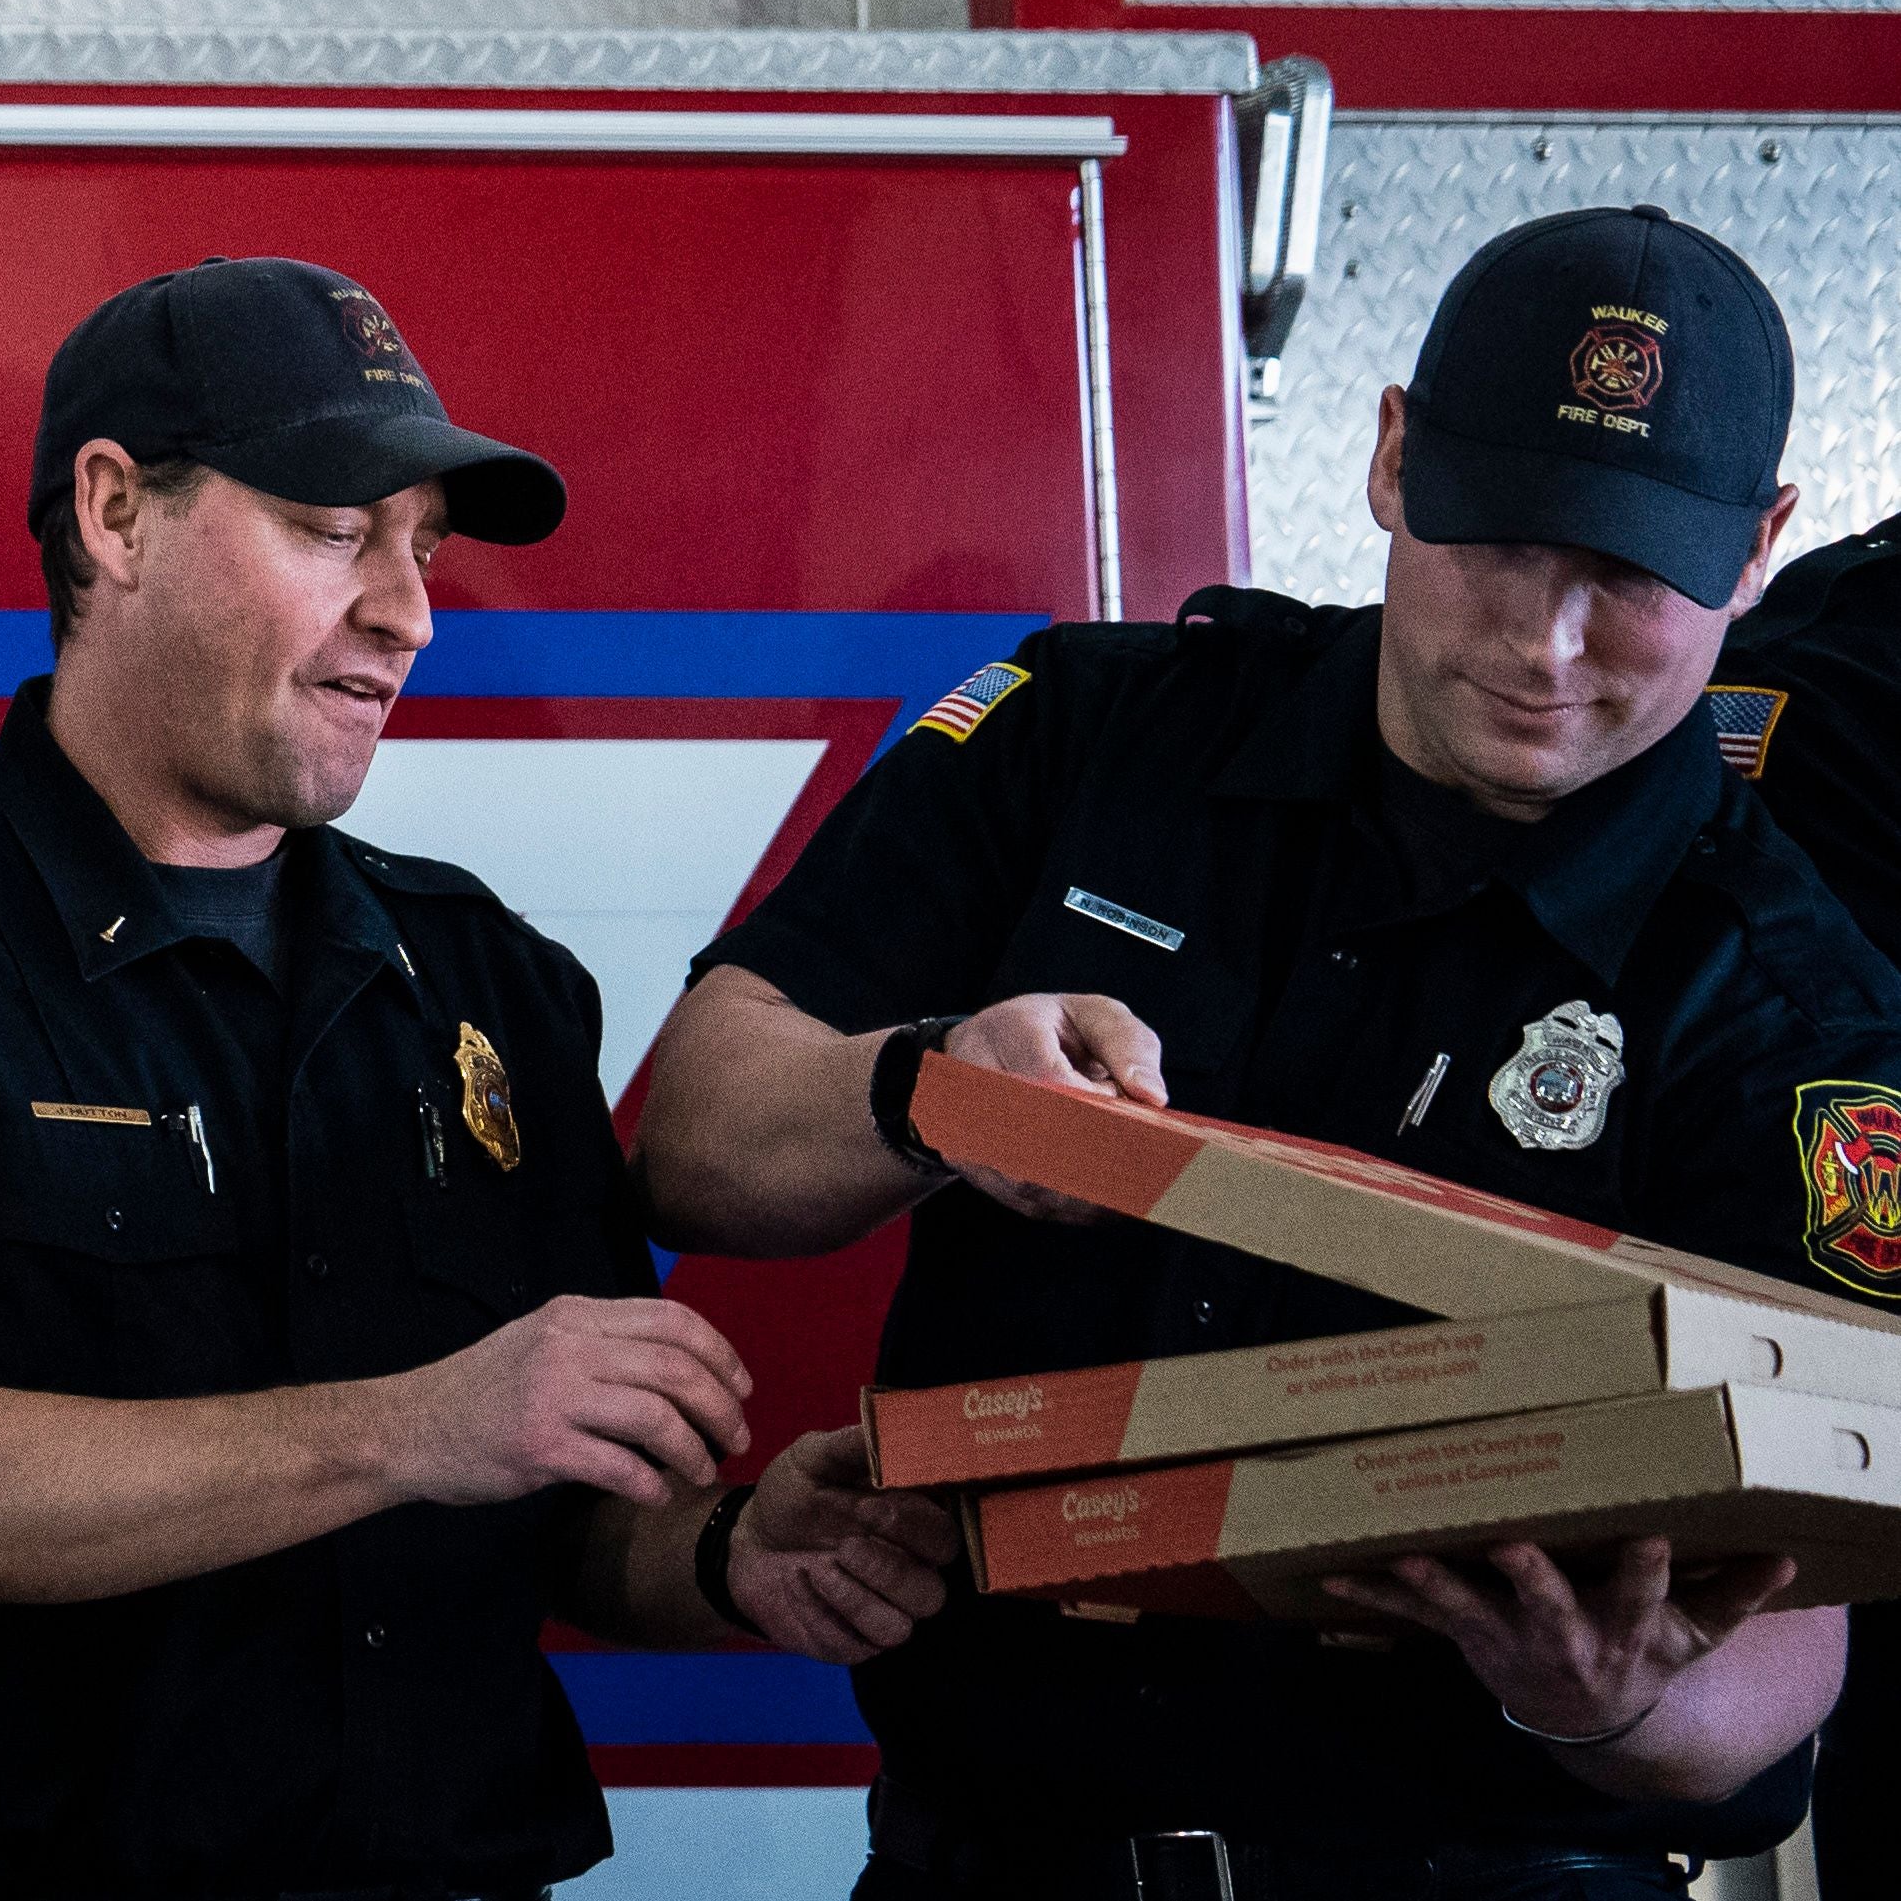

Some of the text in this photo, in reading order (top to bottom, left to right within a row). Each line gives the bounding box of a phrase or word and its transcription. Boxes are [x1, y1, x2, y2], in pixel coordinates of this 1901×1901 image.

[1591, 305, 1669, 336] WAUKEE
[365, 368, 398, 382] FIRE
[1557, 403, 1599, 424] FIRE
[1098, 902, 1169, 941] ROBINSON
[1319, 1347, 1355, 1367] with
[1359, 1343, 1386, 1361] the
[963, 1382, 1044, 1421] Casey's
[975, 1423, 1043, 1445] REWARDS
[1062, 1485, 1140, 1522] Casey's
